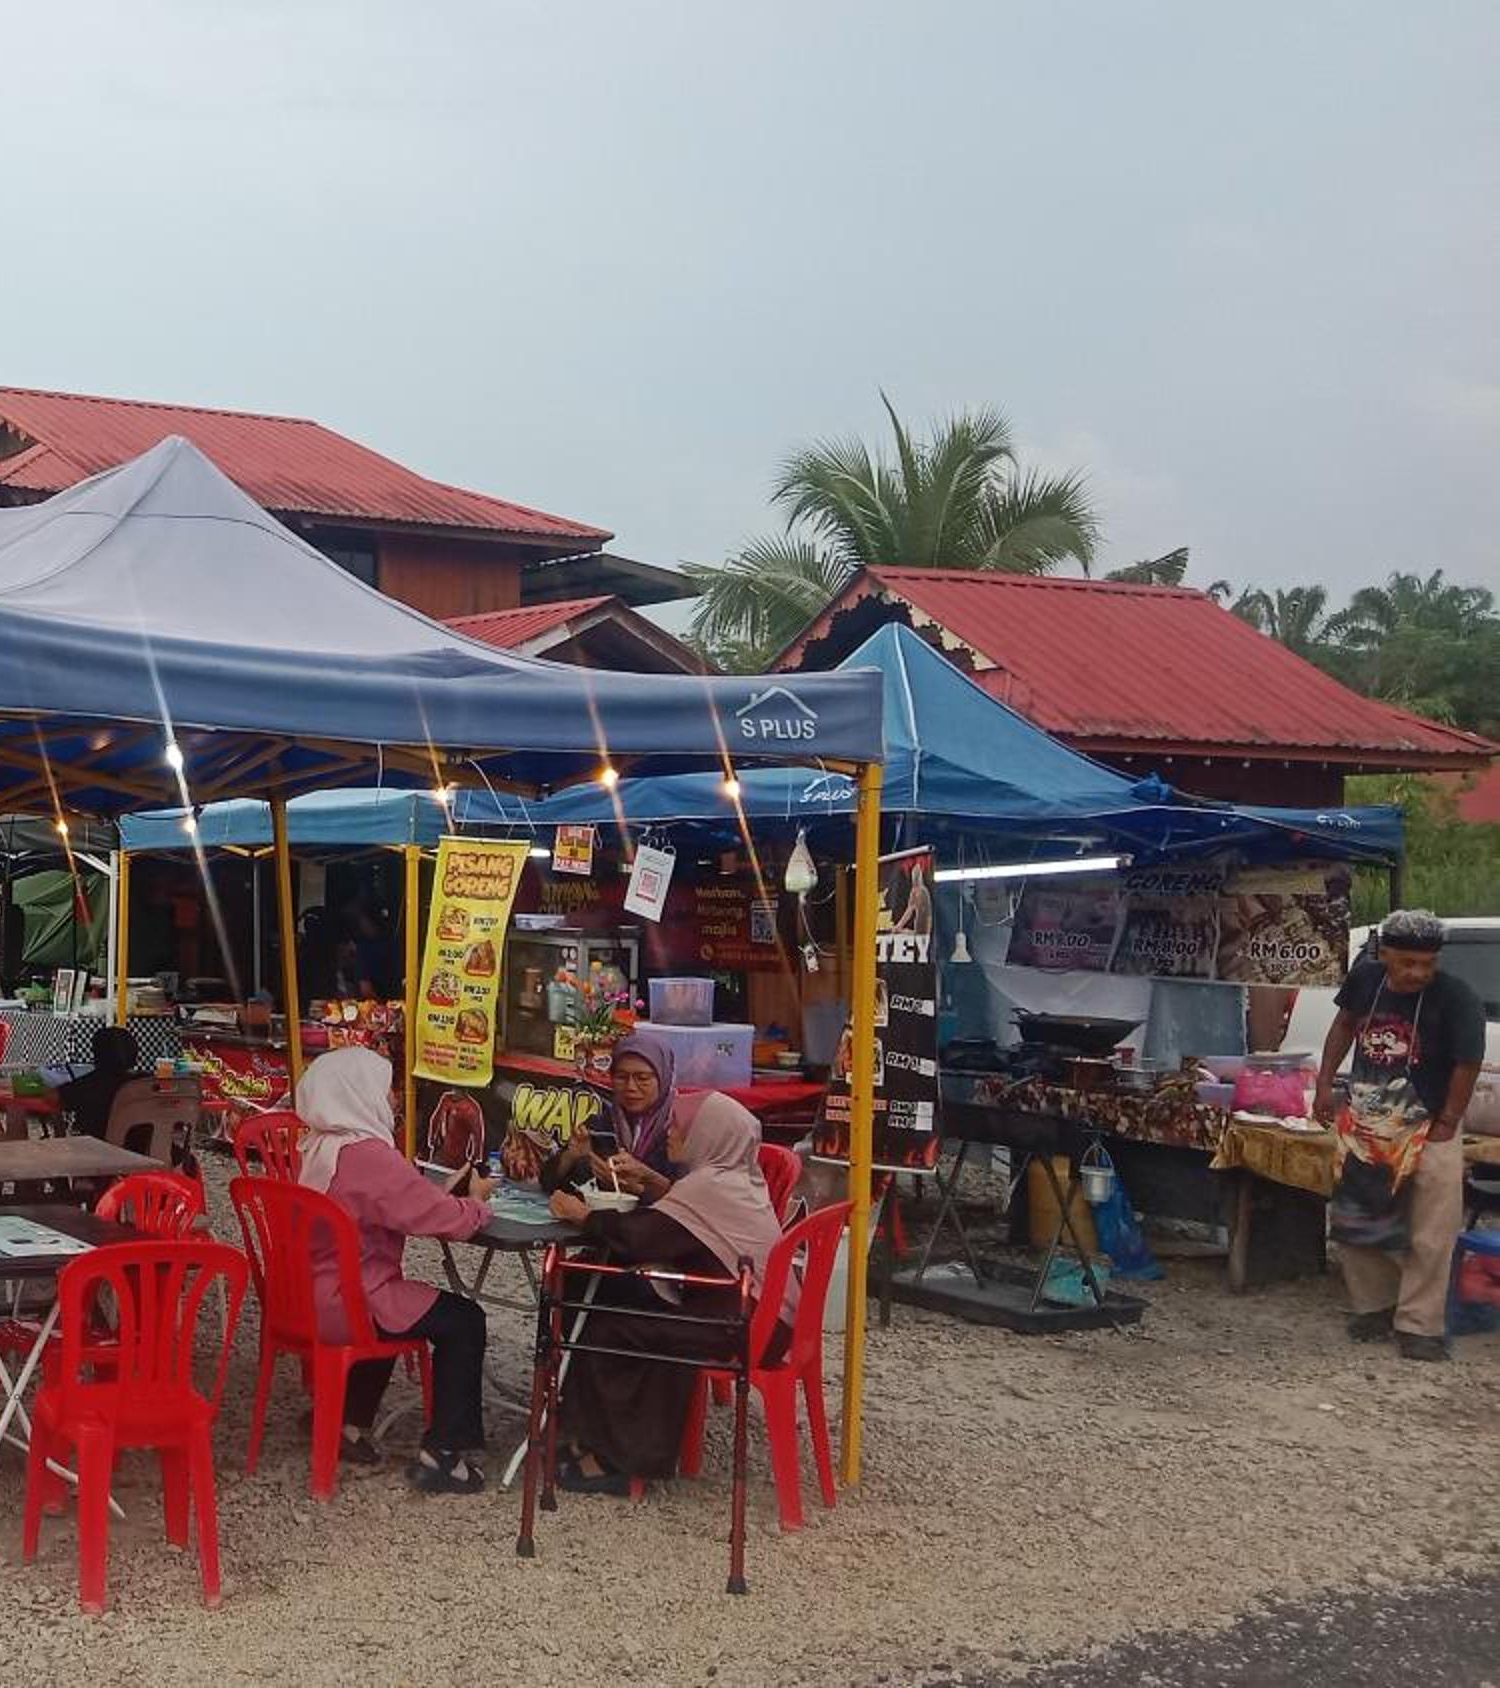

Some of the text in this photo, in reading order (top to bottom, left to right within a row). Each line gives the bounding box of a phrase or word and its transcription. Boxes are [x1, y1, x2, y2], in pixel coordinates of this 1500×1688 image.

[740, 718, 816, 739] S PLUS
[447, 852, 514, 876] PISANG
[443, 876, 510, 899] GORENG
